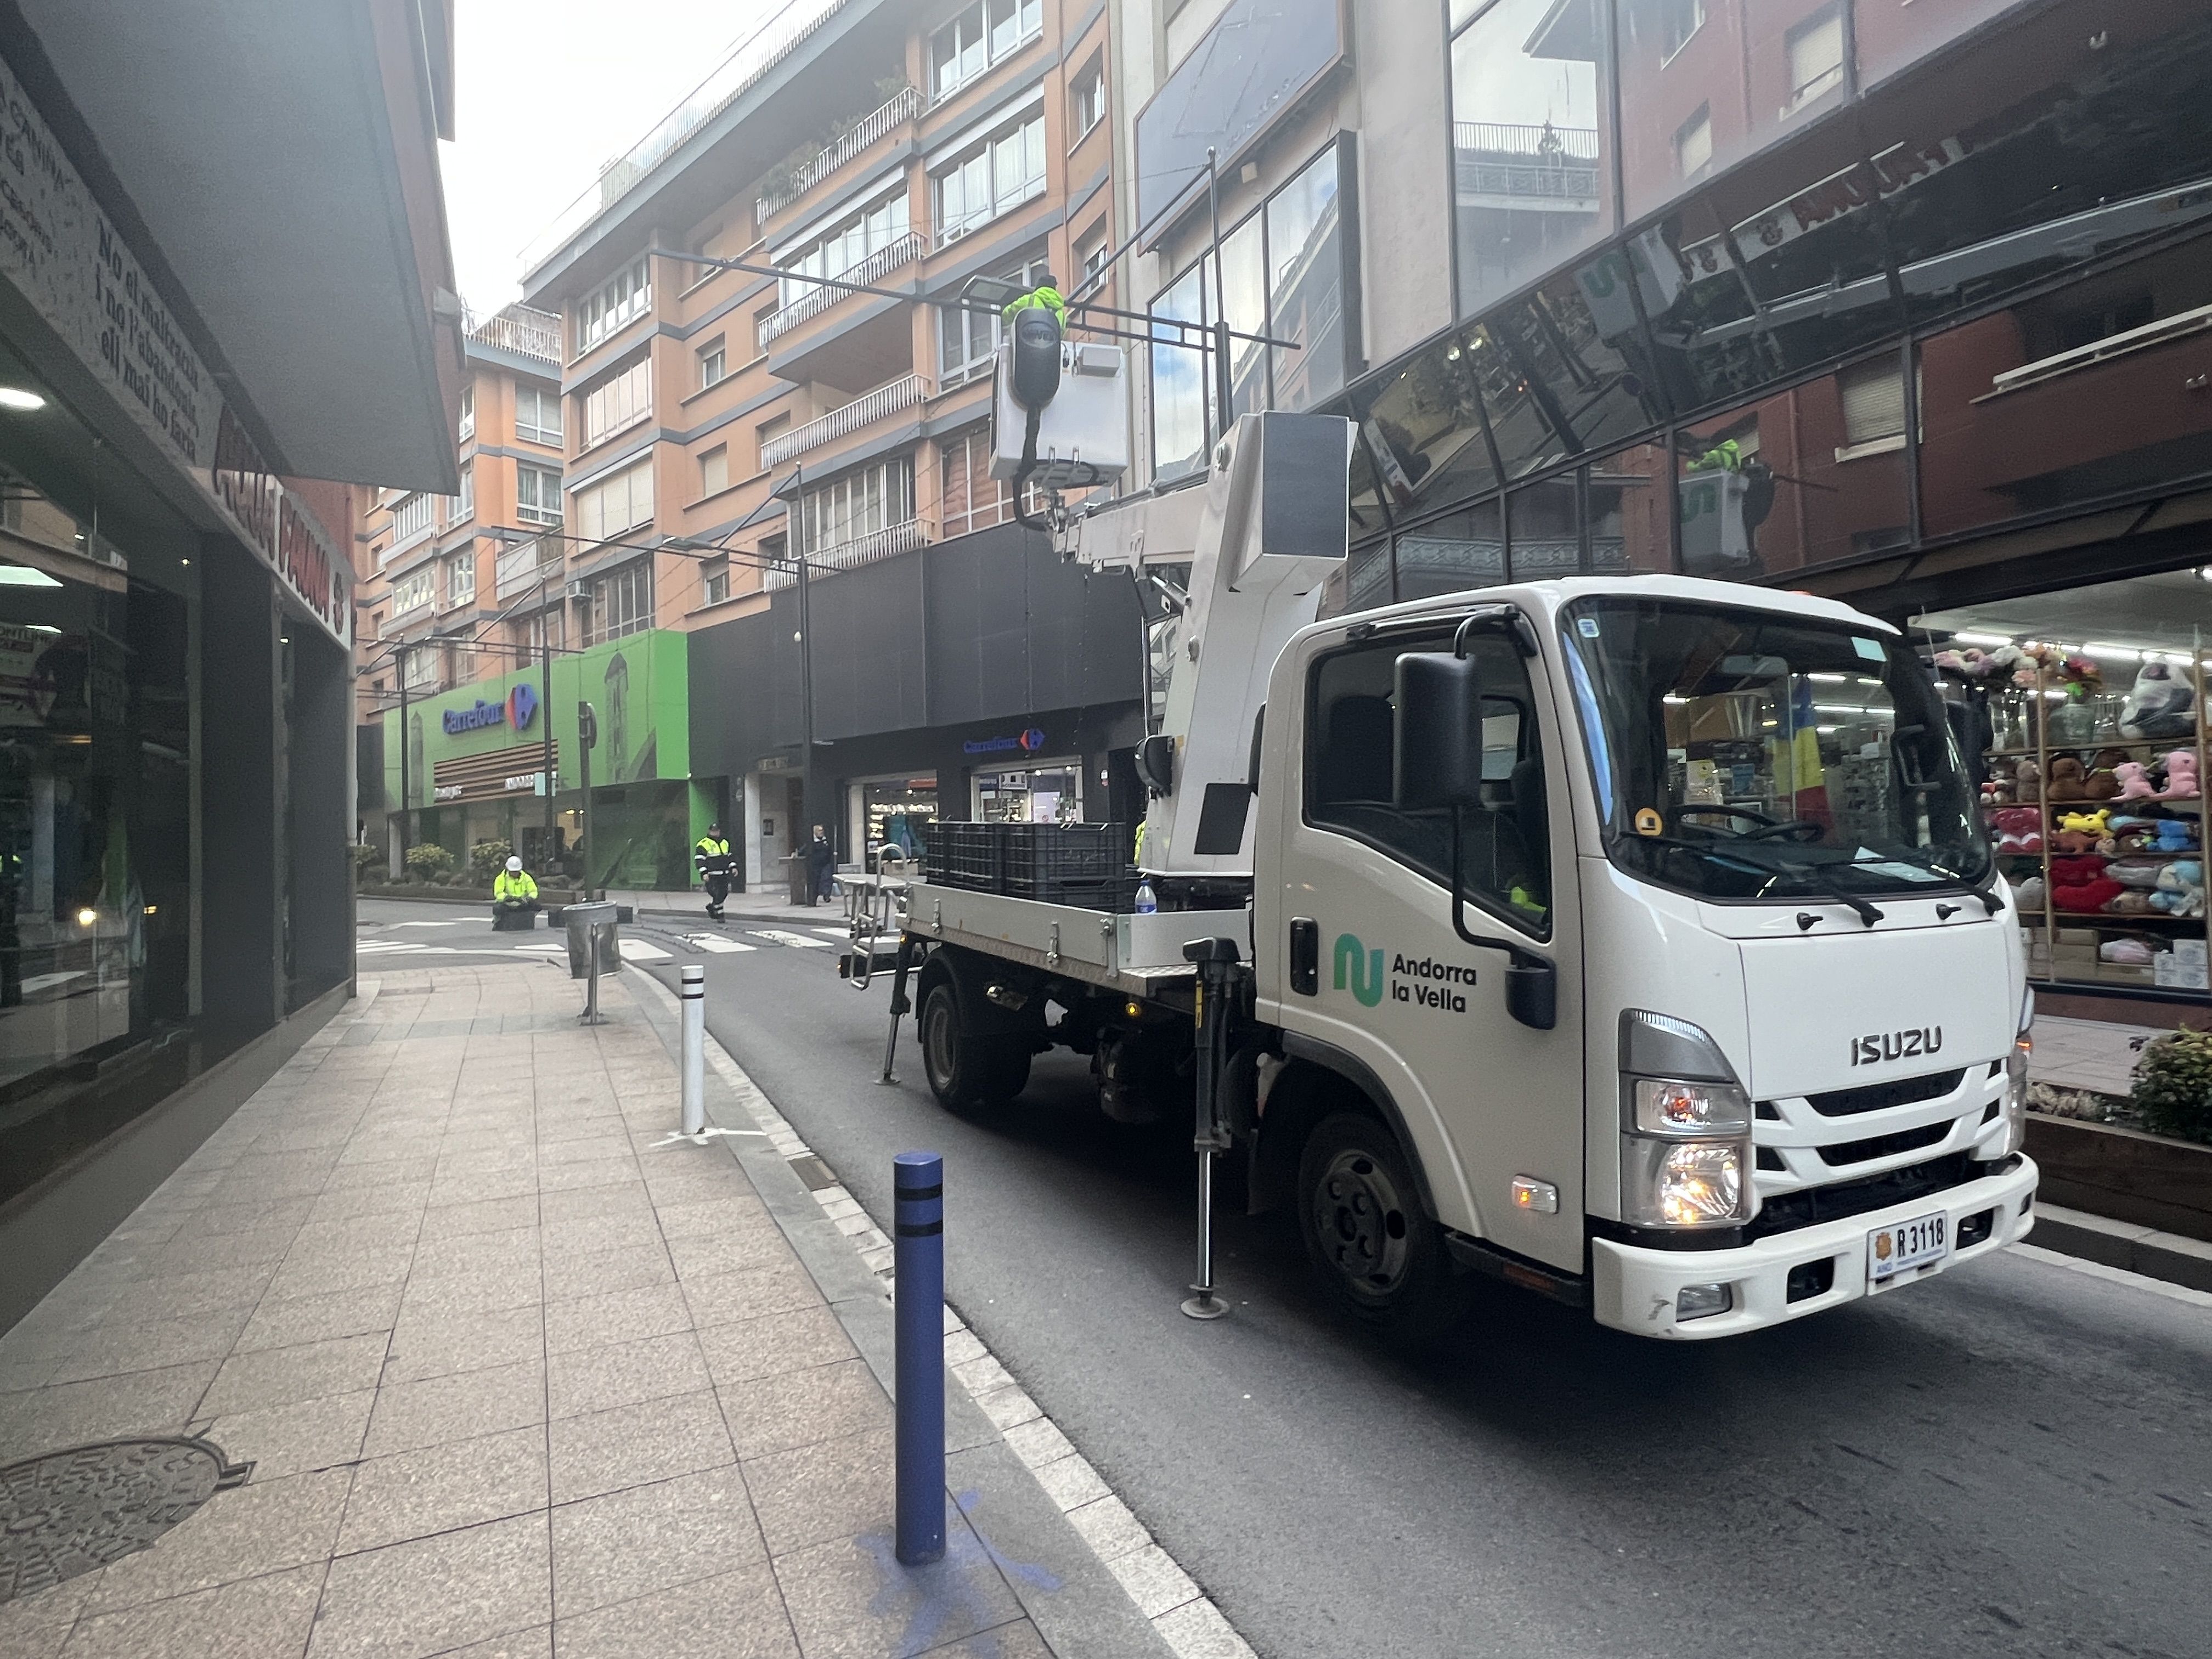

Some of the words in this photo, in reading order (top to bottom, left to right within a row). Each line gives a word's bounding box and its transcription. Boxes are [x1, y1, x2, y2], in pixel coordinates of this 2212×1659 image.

[95, 215, 122, 281] No
[126, 269, 138, 305] el
[105, 286, 125, 332] no
[101, 326, 120, 379] ell
[123, 354, 150, 409] mai
[153, 383, 168, 431] ho
[442, 699, 505, 735] Carrefour
[1392, 953, 1477, 986] Andorra
[1392, 980, 1409, 1002] la
[1414, 984, 1466, 1013] Vella
[1851, 1025, 1942, 1066] ISUZU
